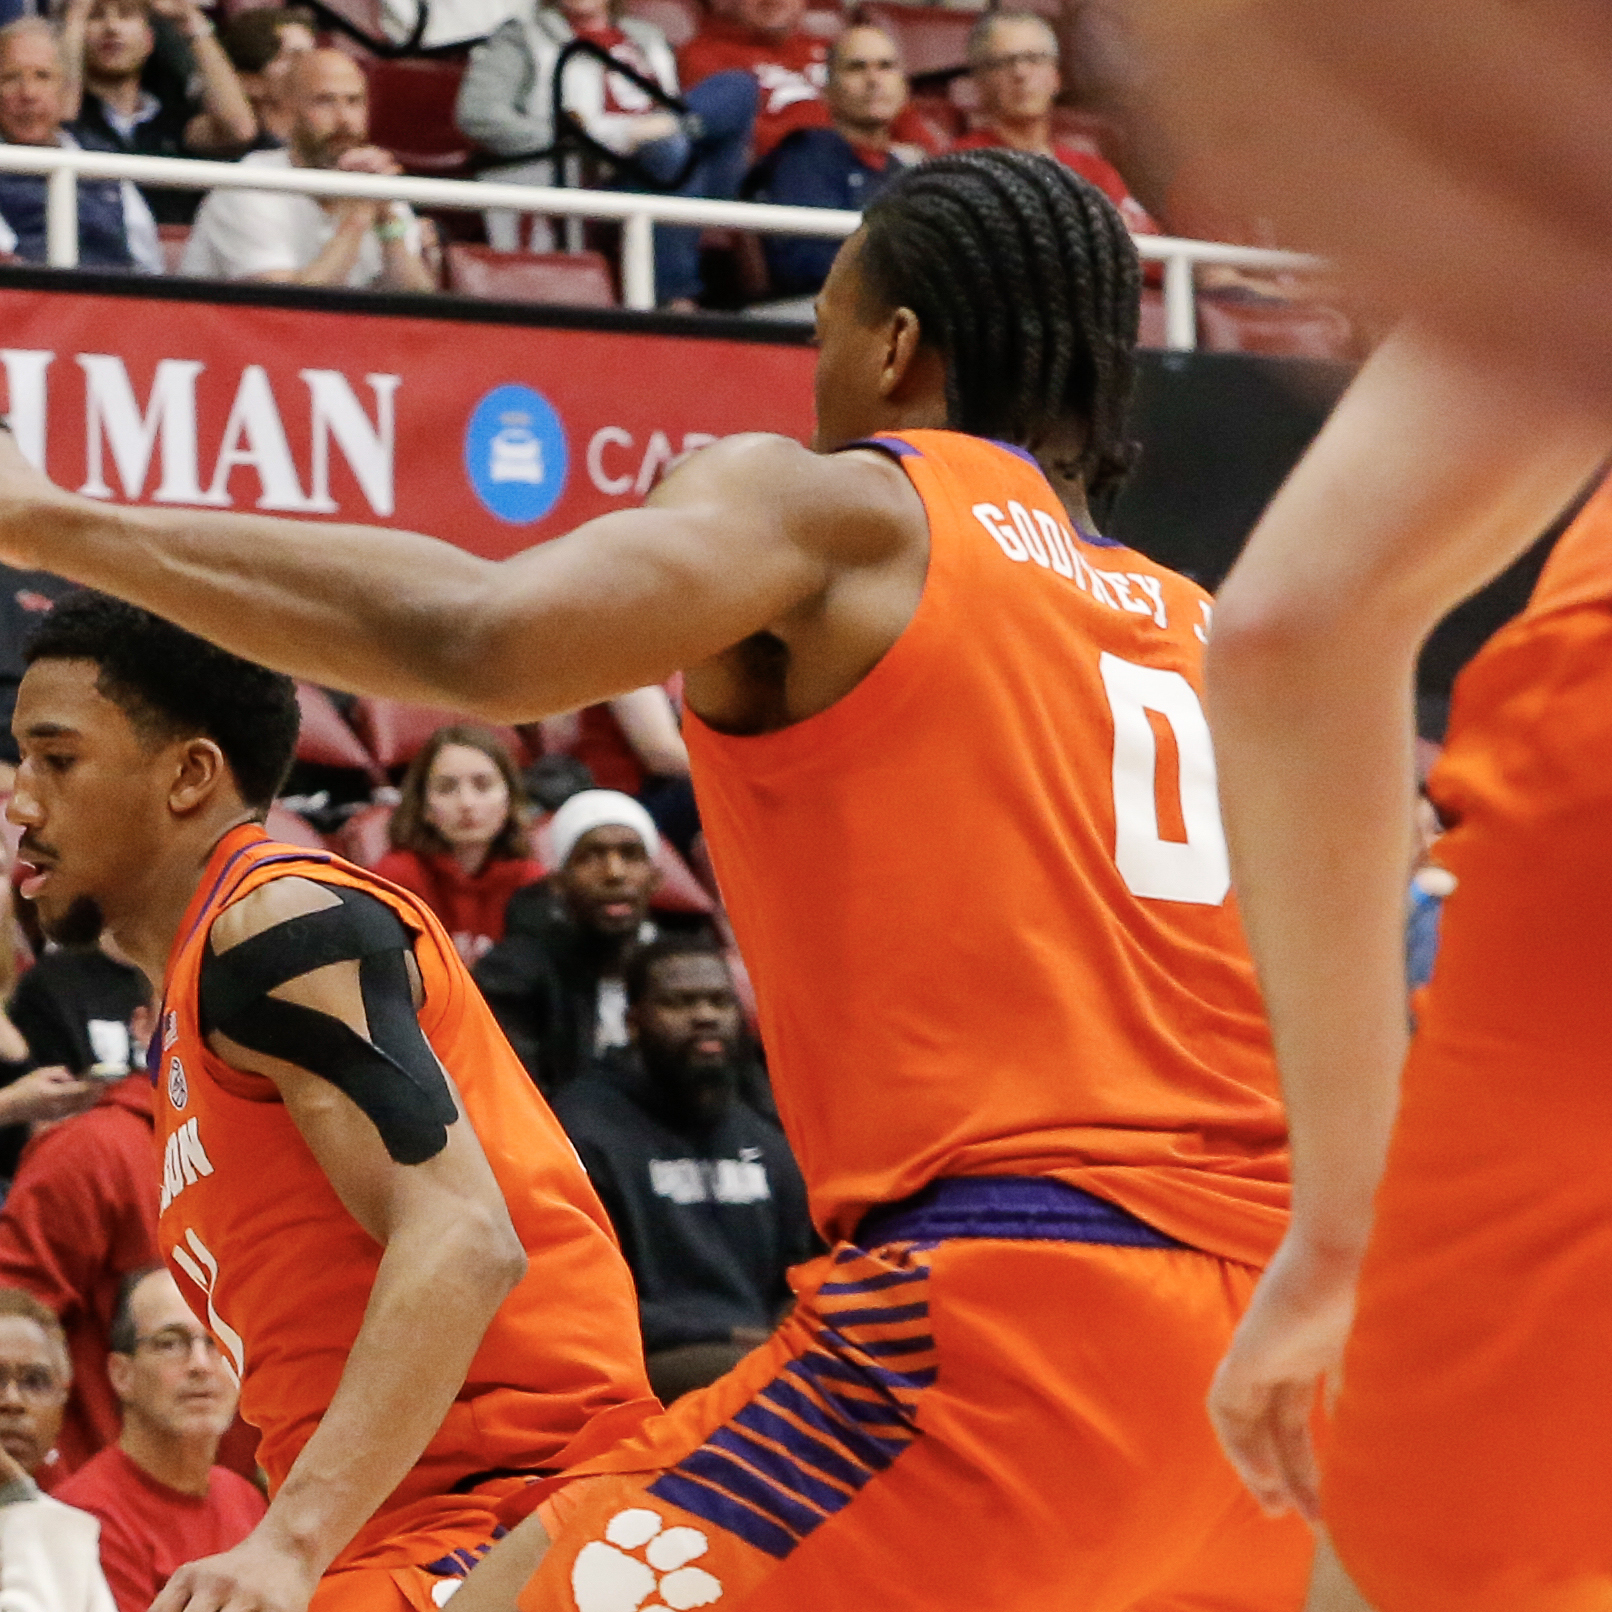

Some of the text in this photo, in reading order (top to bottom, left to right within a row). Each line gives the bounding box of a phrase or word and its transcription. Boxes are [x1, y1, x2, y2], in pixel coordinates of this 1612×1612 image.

[75, 352, 404, 518] MAN
[586, 425, 720, 497] CA
[1099, 650, 1232, 907] 0
